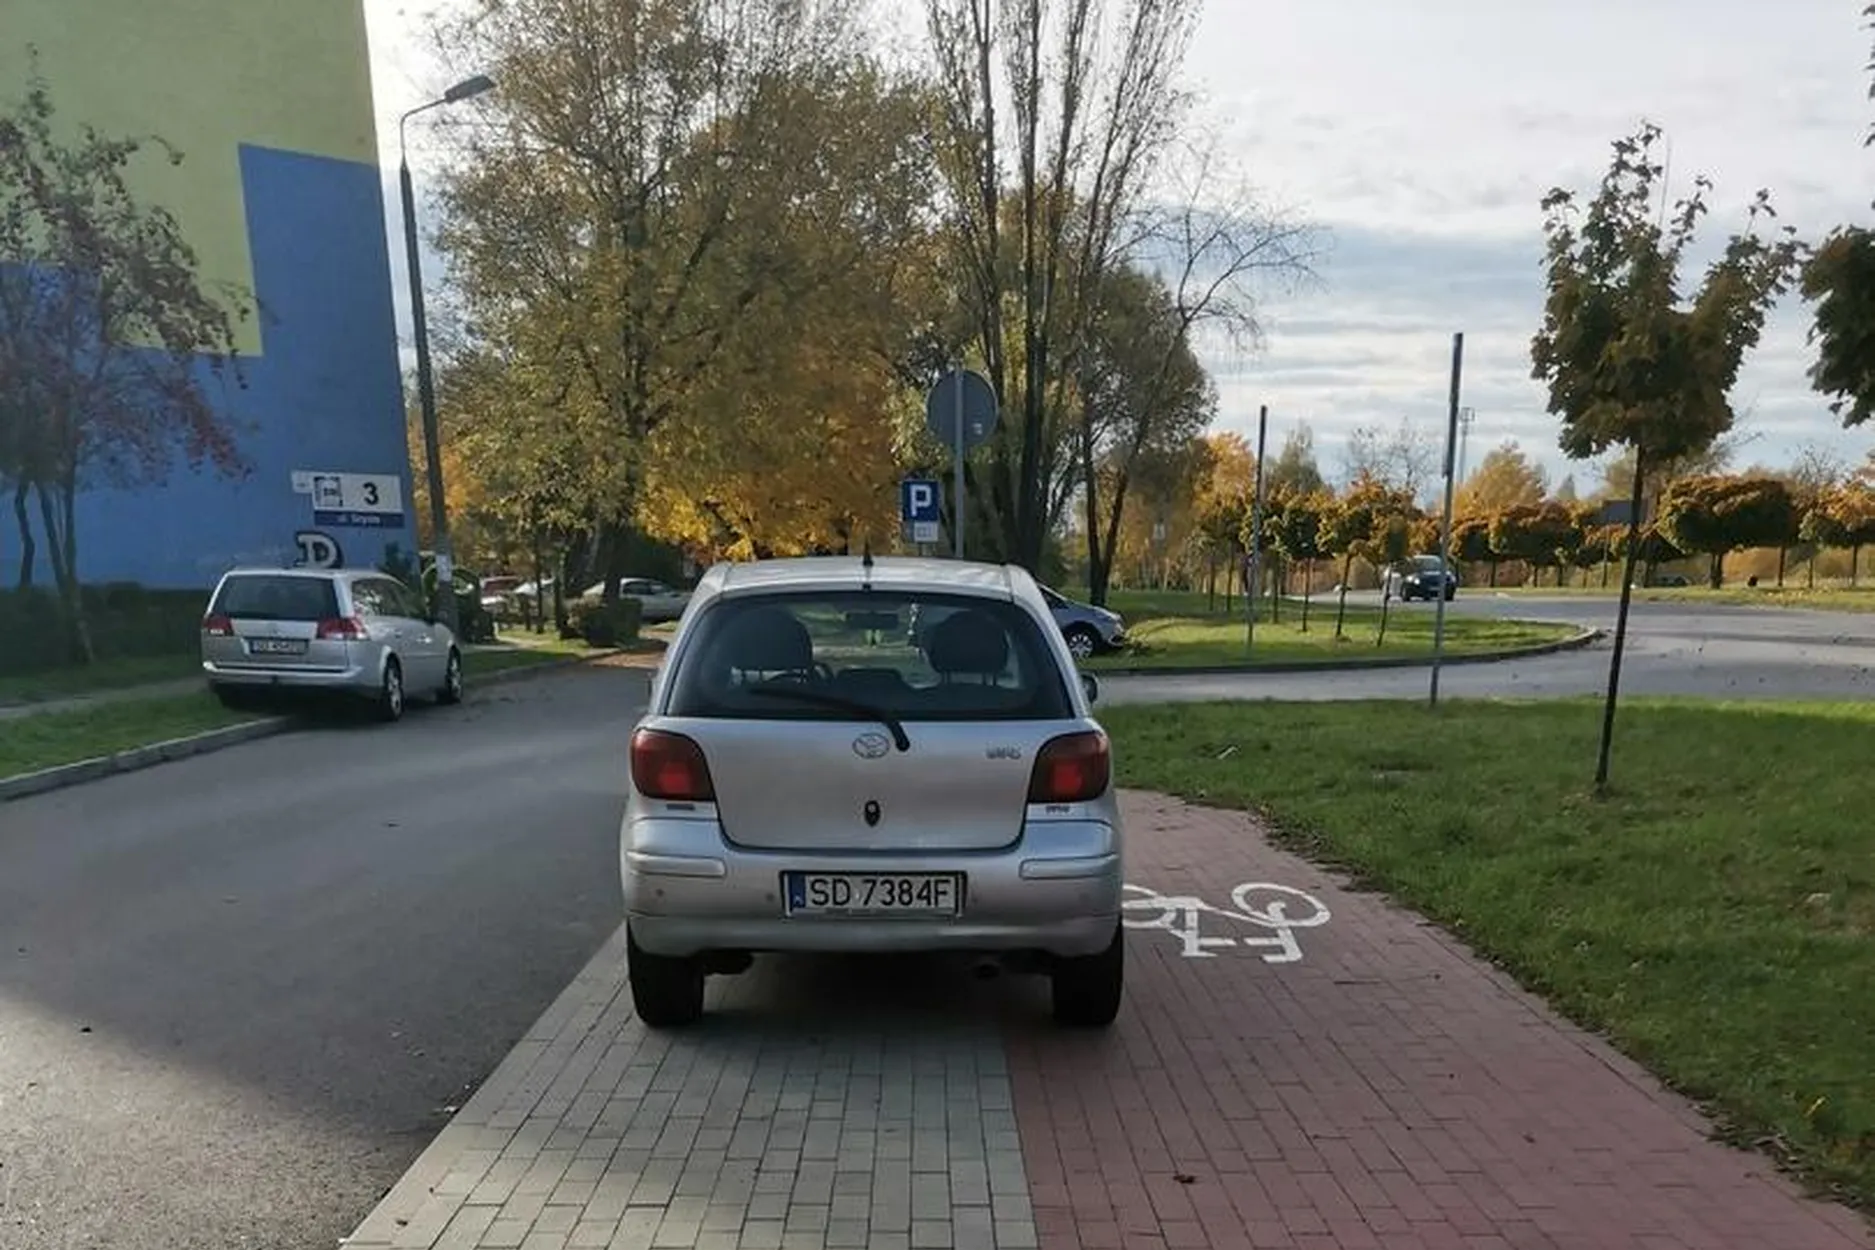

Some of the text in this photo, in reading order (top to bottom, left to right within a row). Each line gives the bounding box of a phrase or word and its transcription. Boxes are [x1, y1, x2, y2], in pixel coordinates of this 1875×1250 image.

[363, 482, 379, 505] 3
[909, 484, 932, 517] P
[810, 878, 951, 907] SD 7384F
